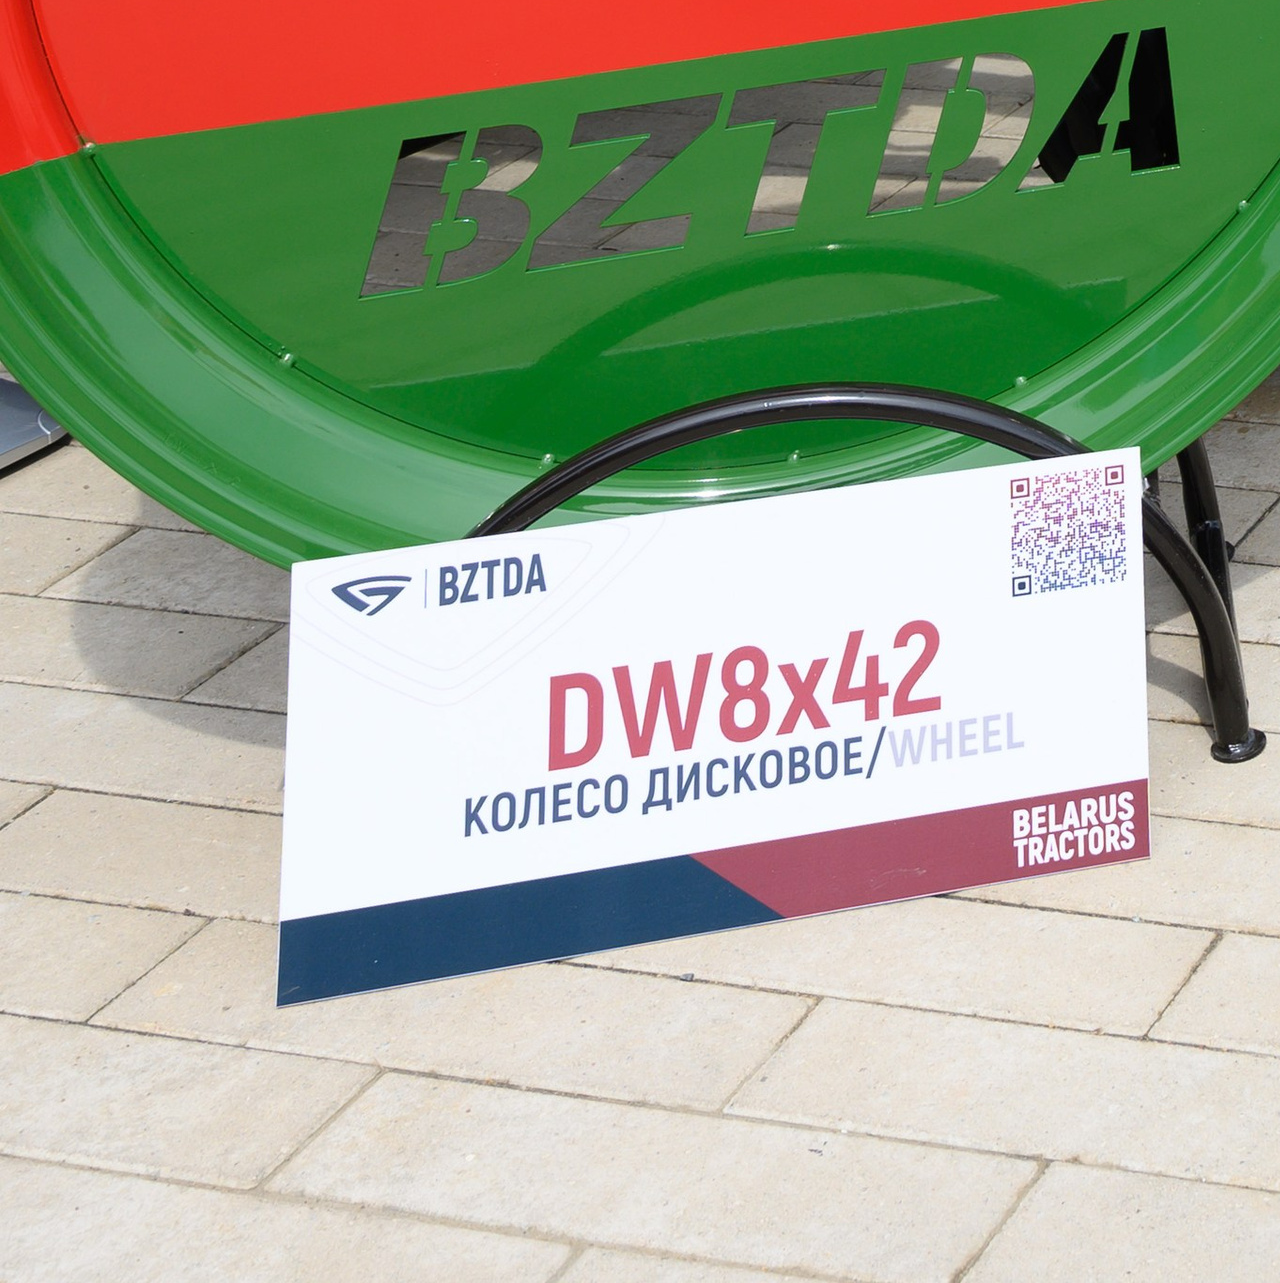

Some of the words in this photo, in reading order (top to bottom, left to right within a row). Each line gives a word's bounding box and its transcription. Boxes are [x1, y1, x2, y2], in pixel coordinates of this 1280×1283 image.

[359, 27, 1181, 301] BZTDA
[437, 552, 547, 608] BZTDA
[548, 619, 942, 772] DW8x42
[464, 773, 630, 837] КОЛЕСО
[1013, 791, 1136, 839] BELARUS
[1013, 820, 1137, 868] TRACTORS
